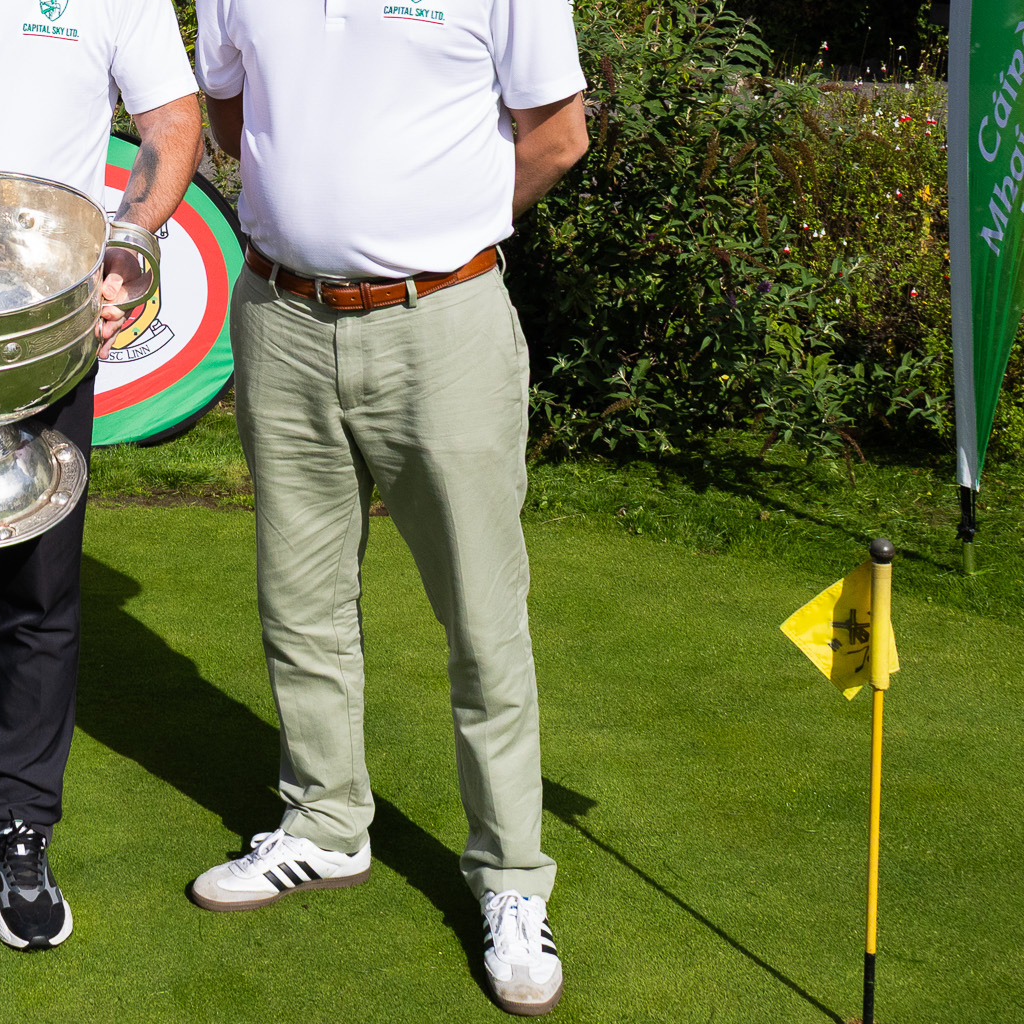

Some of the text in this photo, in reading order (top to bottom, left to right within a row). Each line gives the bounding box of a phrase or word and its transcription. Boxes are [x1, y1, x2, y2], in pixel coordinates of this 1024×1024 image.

[383, 5, 445, 21] CAPITAL SKY LTD.
[22, 23, 80, 38] CAPITAL SKY LTD.
